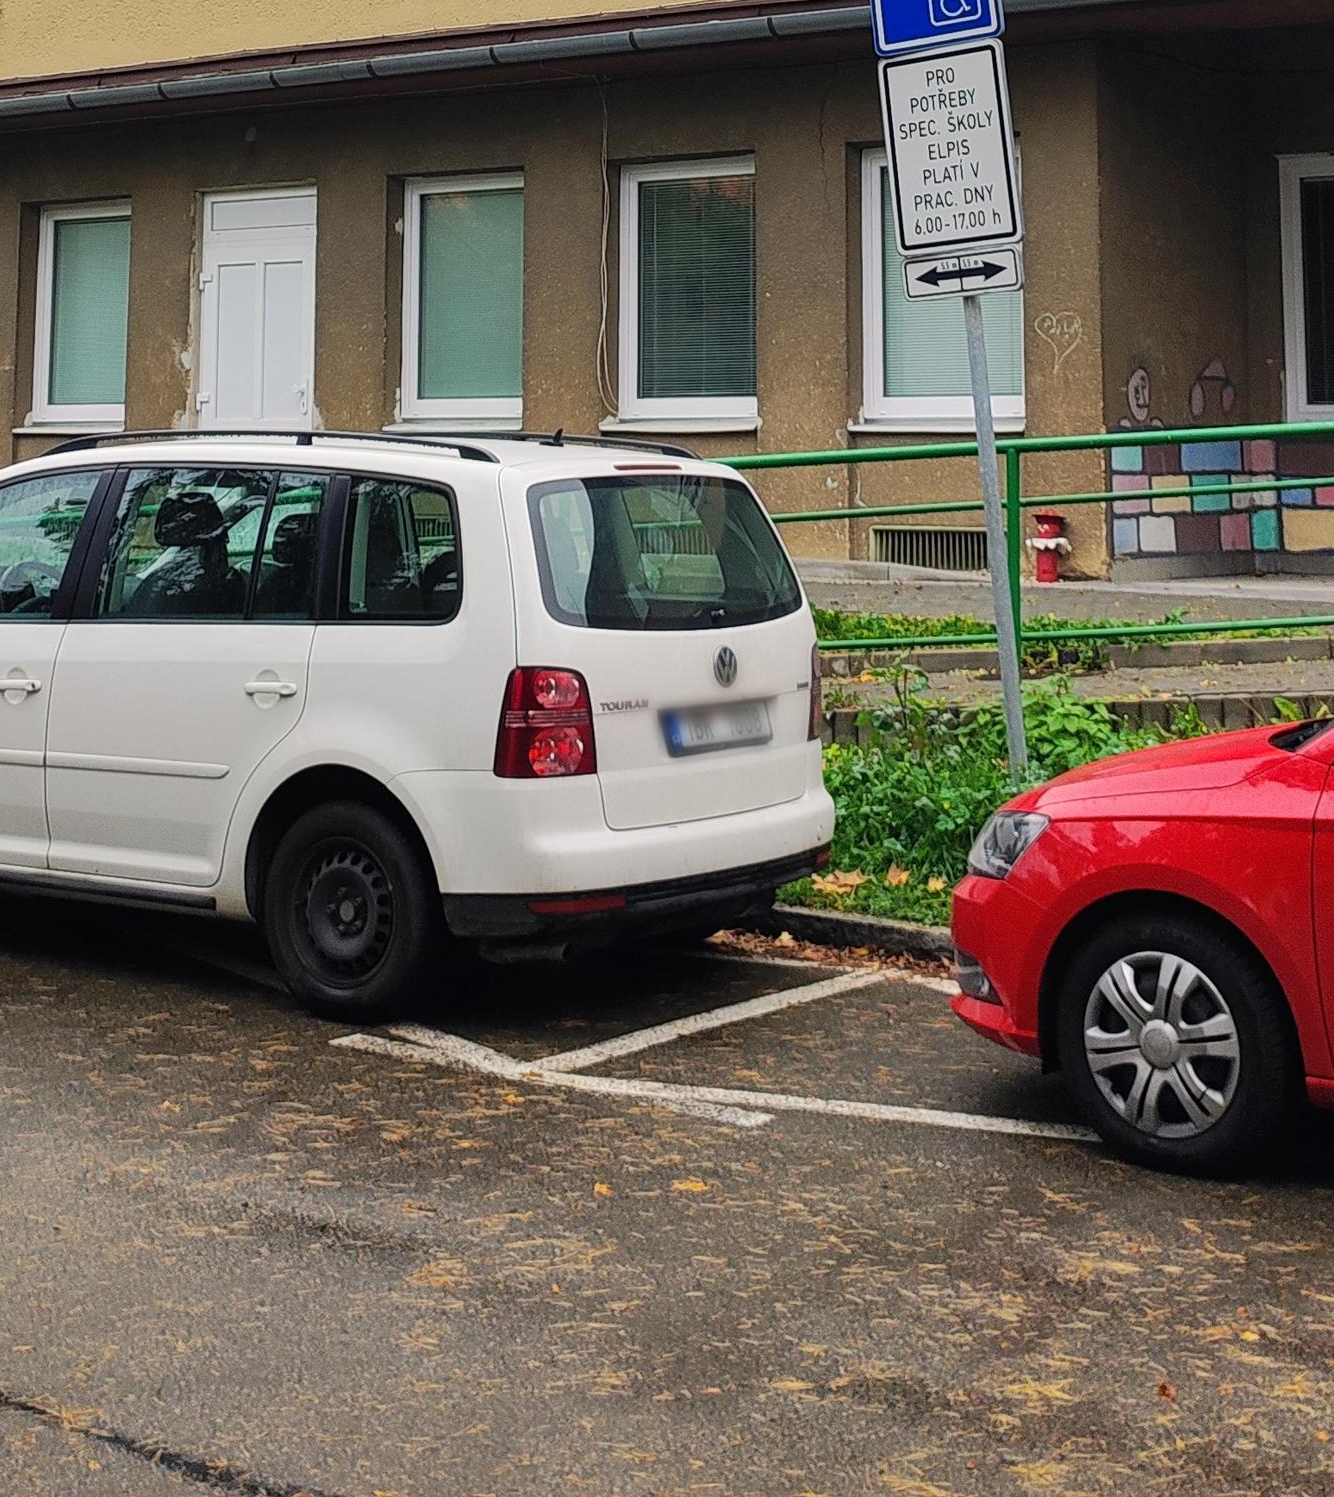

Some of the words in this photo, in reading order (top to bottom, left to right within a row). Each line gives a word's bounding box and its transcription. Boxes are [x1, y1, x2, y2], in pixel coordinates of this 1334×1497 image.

[925, 67, 956, 87] PRO
[909, 87, 976, 114] POTŘEBY
[899, 119, 941, 140] SPEC.
[947, 110, 993, 133] ŠKOLY
[927, 139, 970, 160] ELPIS
[922, 159, 964, 186] PLATÍ
[969, 161, 980, 179] V
[914, 190, 958, 212] PRAC.
[963, 184, 994, 205] DNY
[992, 208, 1002, 225] h
